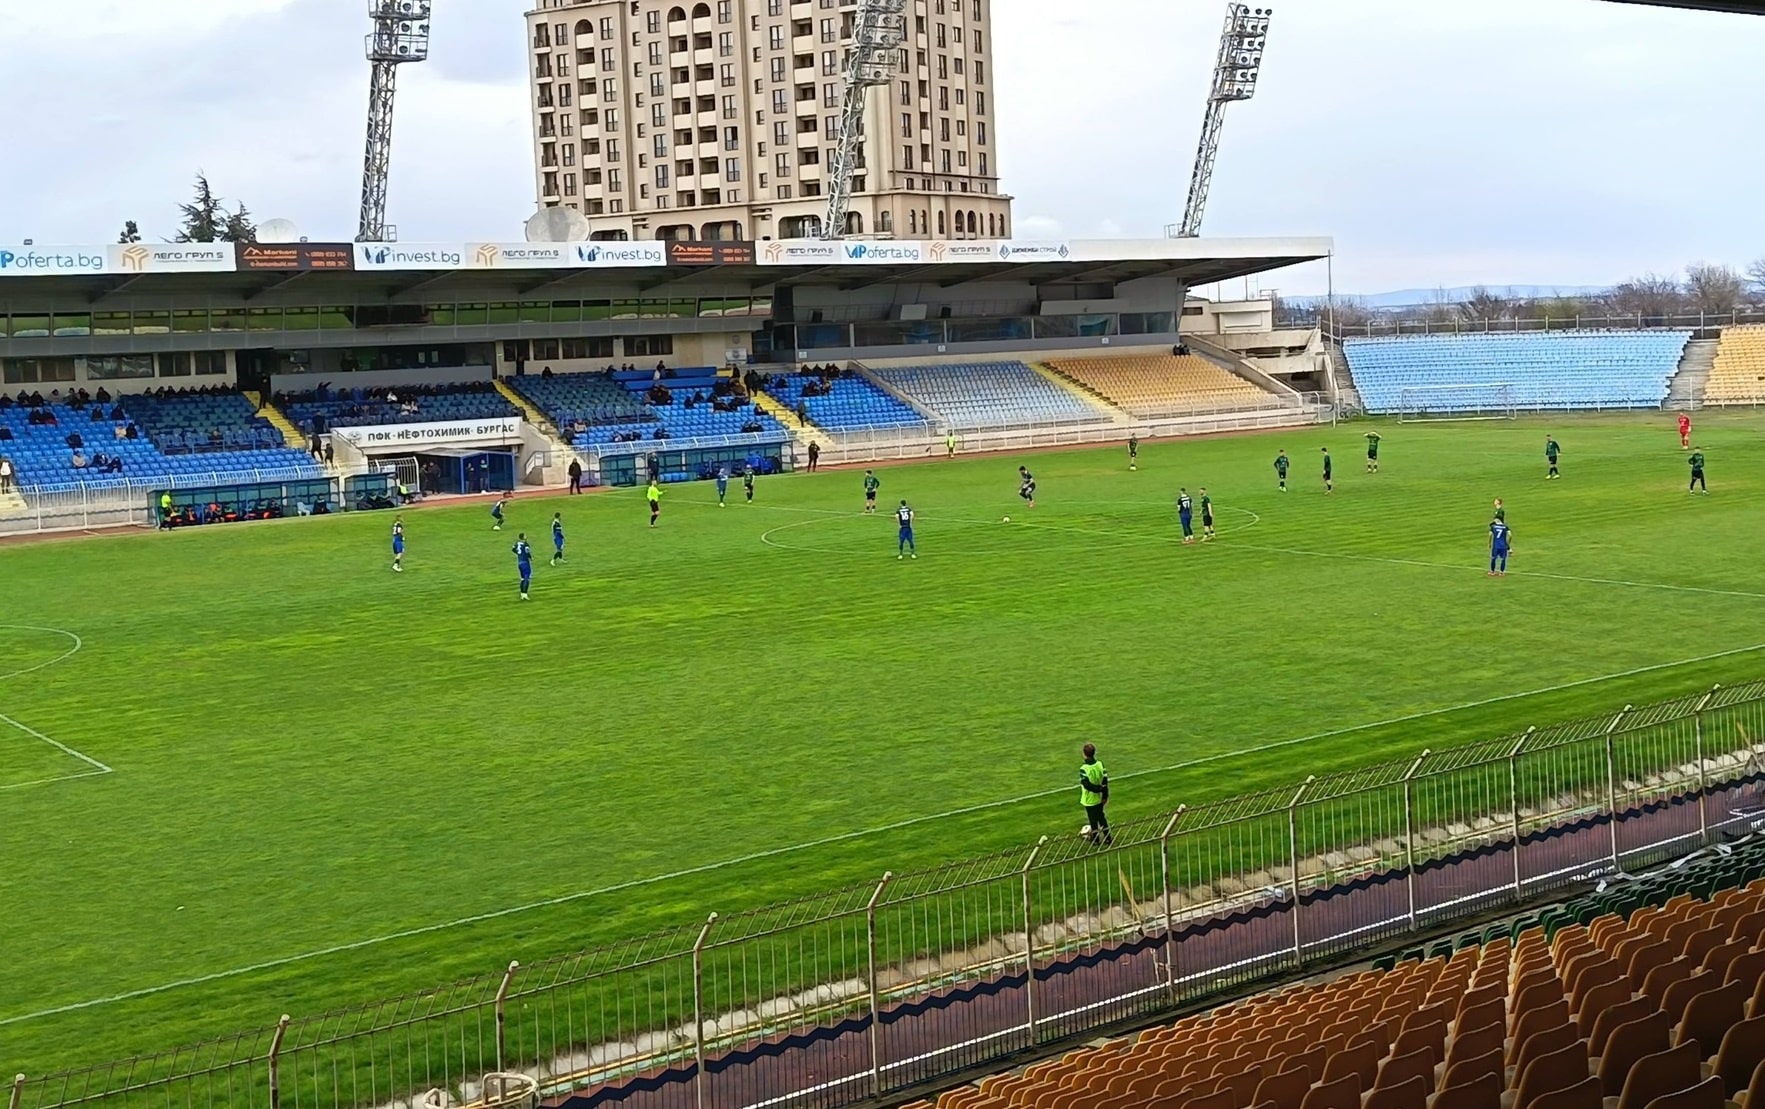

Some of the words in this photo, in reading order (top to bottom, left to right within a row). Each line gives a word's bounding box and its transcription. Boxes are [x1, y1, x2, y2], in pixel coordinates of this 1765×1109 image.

[368, 431, 391, 441] ПФК
[397, 427, 470, 440] НЕФТОХИМИК
[476, 424, 515, 435] БУРГАС
[1496, 529, 1503, 538] 7
